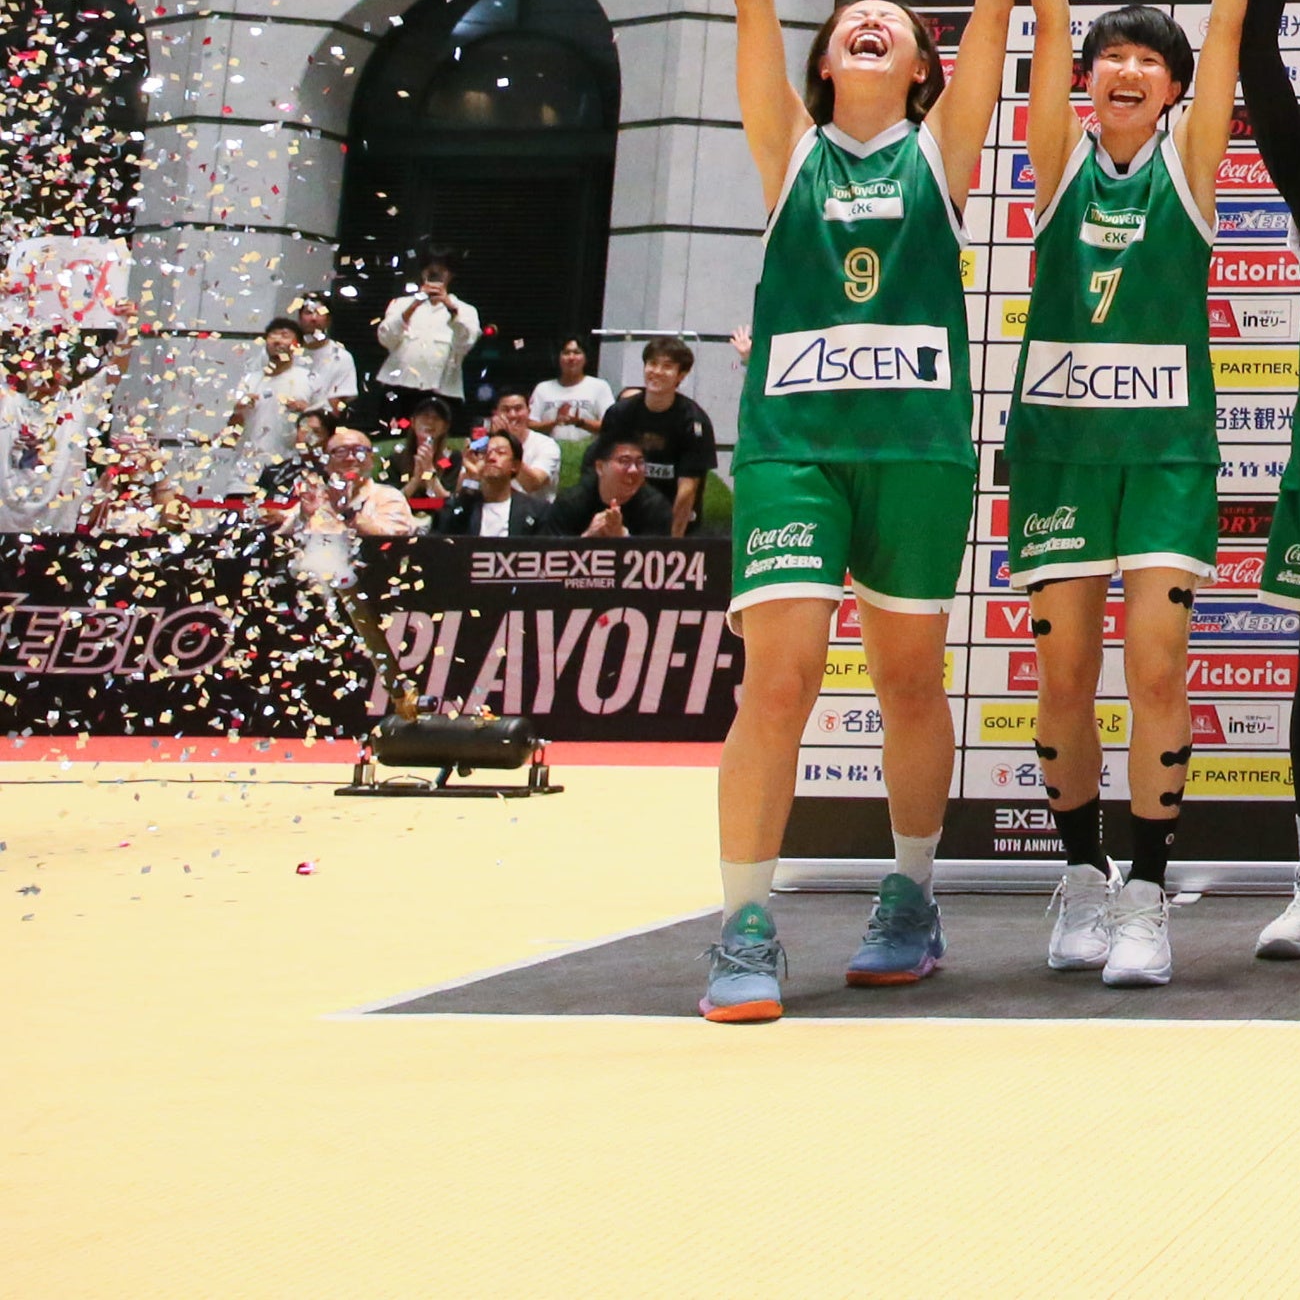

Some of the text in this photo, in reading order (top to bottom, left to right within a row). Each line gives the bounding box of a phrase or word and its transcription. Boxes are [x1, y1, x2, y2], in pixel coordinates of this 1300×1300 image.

[844, 246, 881, 303] 9
[1209, 255, 1300, 282] ictoria
[1088, 267, 1122, 324] 7
[1027, 350, 1183, 401] ASCENT
[1220, 362, 1292, 375] PARTNER
[746, 521, 818, 556] Coca-Cola
[564, 578, 616, 589] PREMIER
[622, 550, 707, 591] 2024
[1223, 610, 1300, 633] XEBIO
[367, 607, 742, 715] PLAYOFF
[984, 716, 1026, 729] GOLF
[1206, 770, 1281, 783] PARTNER
[993, 838, 1021, 851] 10TH
